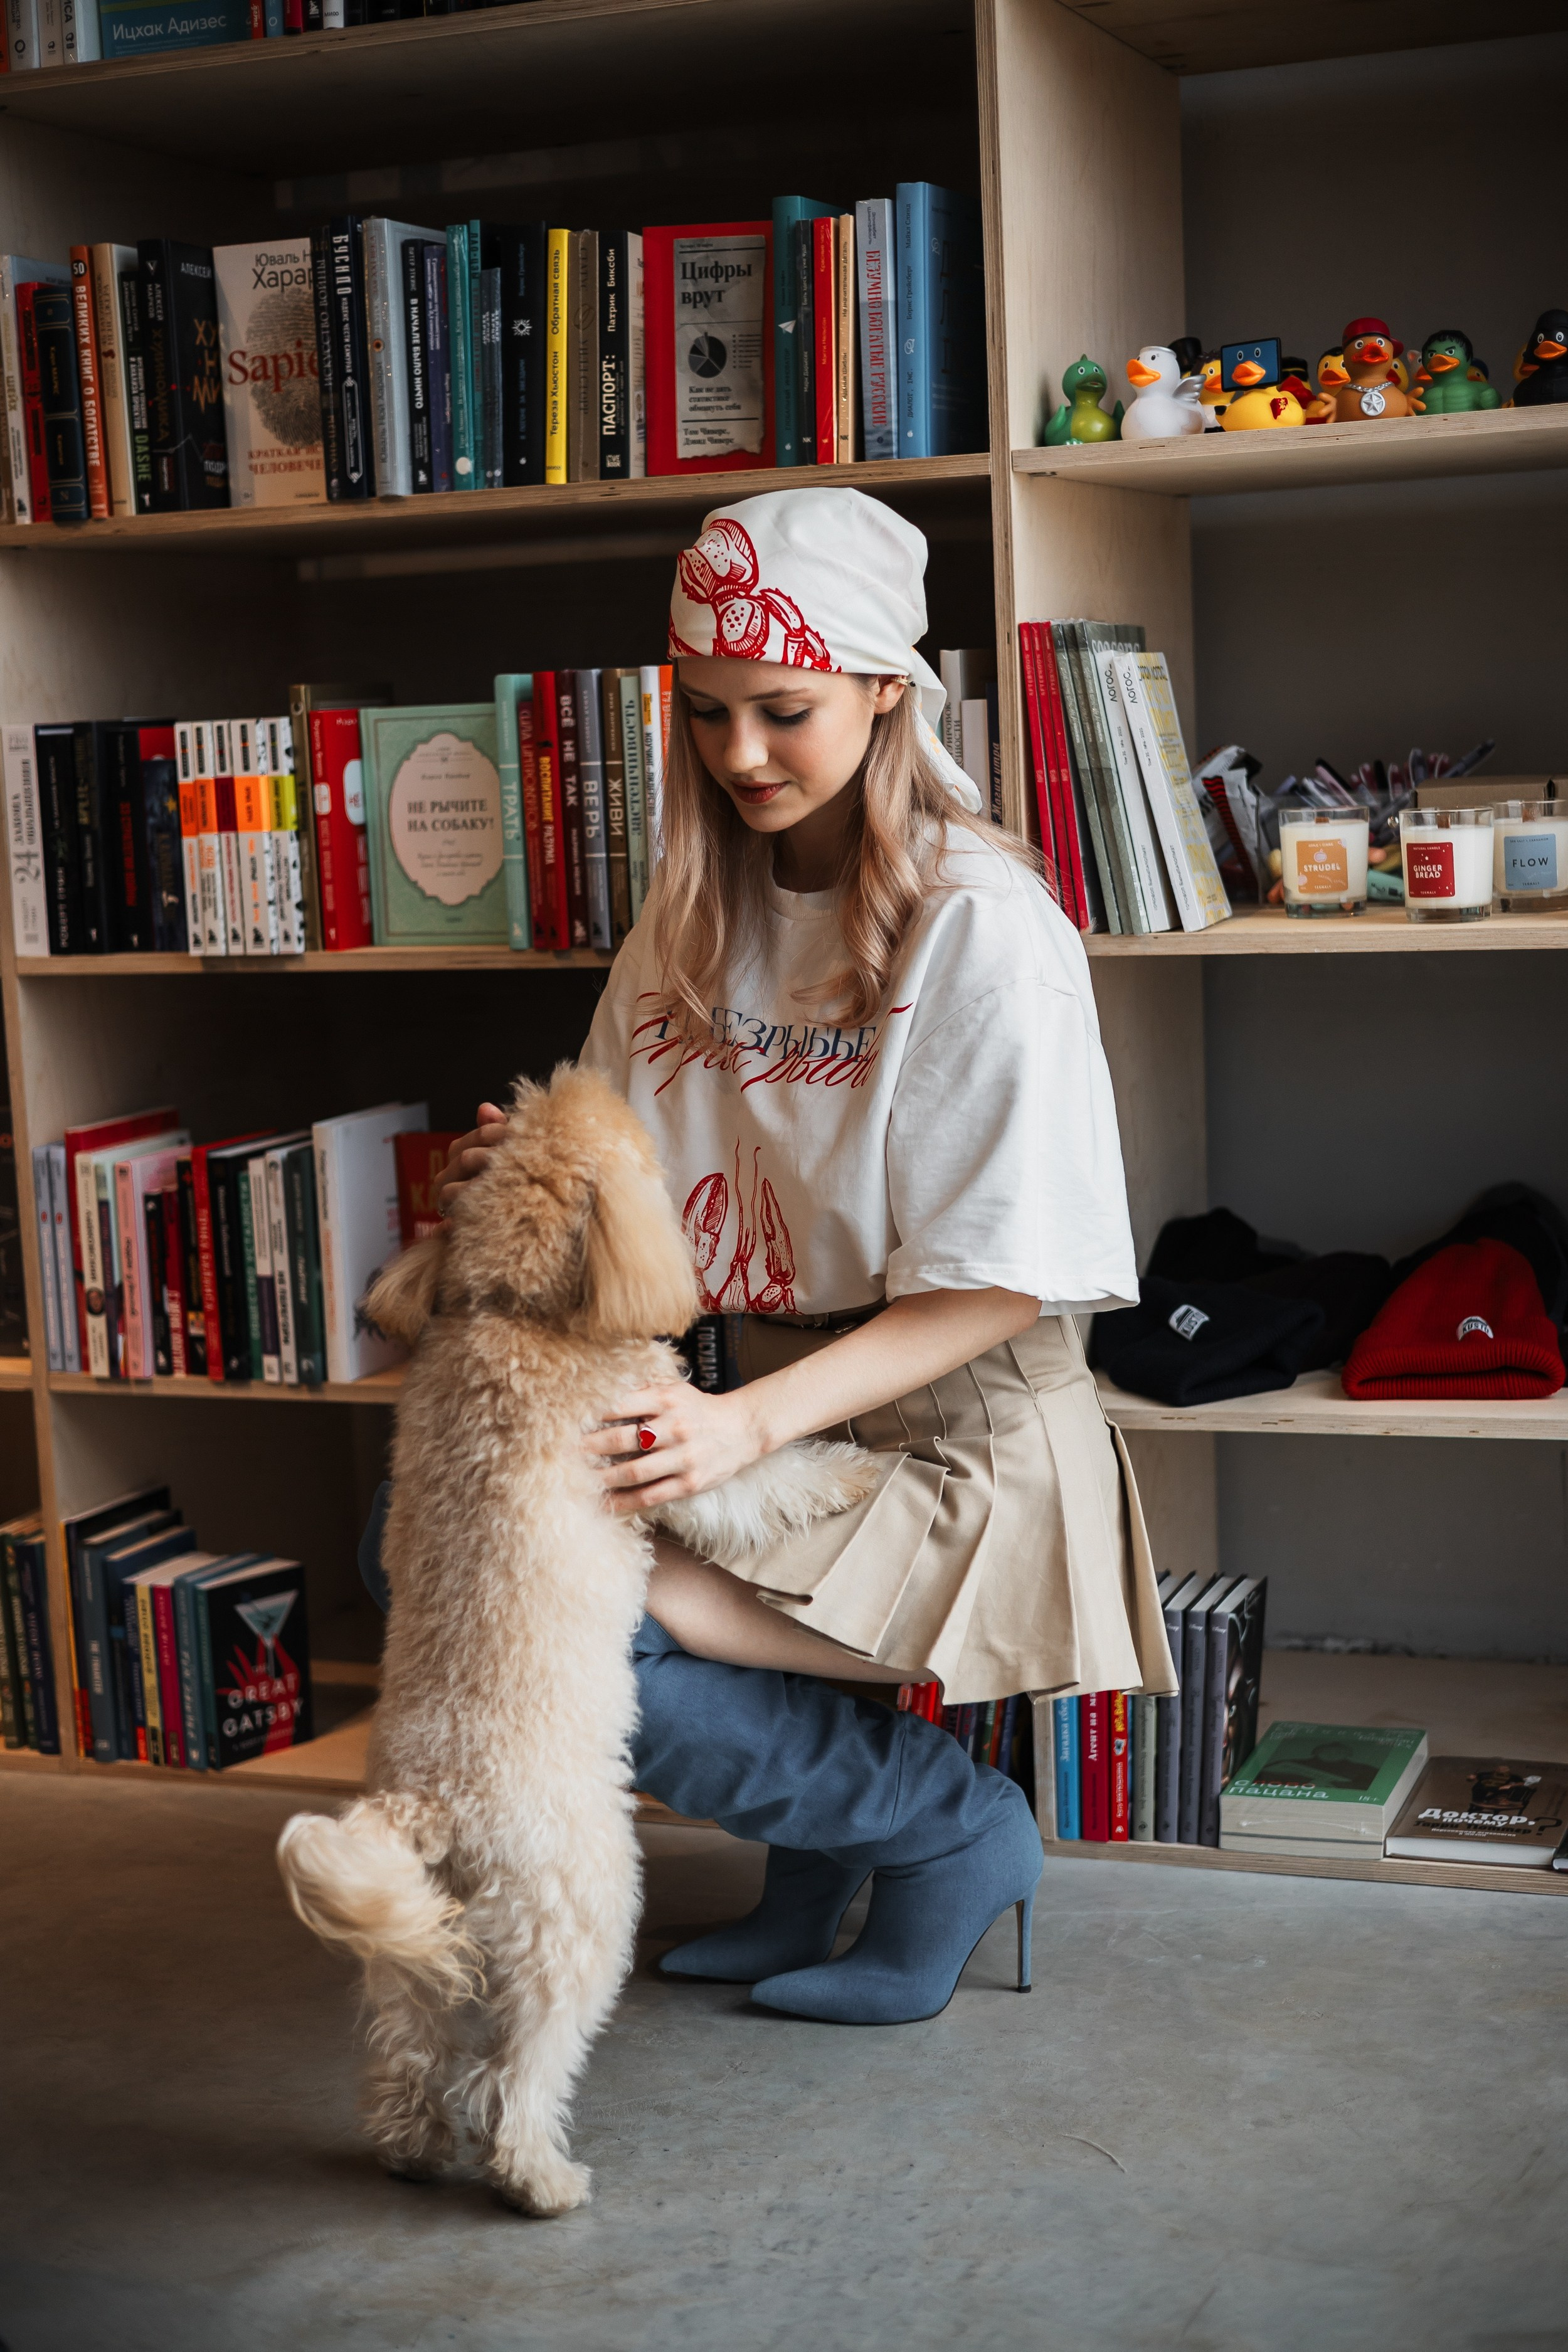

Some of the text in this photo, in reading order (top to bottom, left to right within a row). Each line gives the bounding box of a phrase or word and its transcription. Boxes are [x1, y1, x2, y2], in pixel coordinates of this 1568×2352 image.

[113, 15, 227, 40] Ицхак Адизес
[73, 263, 87, 275] 50
[255, 253, 300, 268] Юваль
[332, 235, 352, 295] БУСИДО
[408, 246, 416, 266] ПИТЕР
[681, 261, 752, 283] Цифры
[551, 249, 560, 335] Обратная связь
[606, 248, 618, 332] Патрик Биксби
[681, 290, 730, 309] врут
[905, 265, 913, 299] Гройсберг
[146, 284, 155, 319] МАРКОВ
[154, 283, 164, 320] АЛЕКСЕЙ
[315, 258, 334, 386] ИСКУССТВО ВОЙНЫ
[341, 297, 352, 373] КОДЕКС ЧЕСТИ САМУРАЯ
[410, 307, 421, 344] НАЧАЛЕ
[866, 250, 888, 428] БЕЗУМНО БОГАТЫЕ РУССКИЕ
[75, 286, 100, 467] ВЕЛИКИХ КНИГ О БОГАТСТВЕ
[411, 346, 422, 376] БЫЛО
[149, 329, 169, 442] ХУЛИНОМИКА
[413, 378, 425, 410] НИЧТО
[550, 351, 559, 436] Тереза Хьюстон
[601, 354, 617, 436] ПАСПОРТ:
[559, 695, 578, 807] ВСЁ НЕ ТАК
[624, 699, 642, 836] ЗАСТЕНЧИВОСТЬ
[991, 742, 1002, 819] Магия утра
[430, 798, 487, 813] РЫЧИТЕ
[502, 781, 519, 840] ТРАТЬ
[539, 755, 556, 865] ВОСПИТАНИЕ РАЗУМА
[582, 780, 600, 839] ВЕРЬ
[608, 777, 623, 837] ЖИВИ
[408, 819, 428, 833] НА
[12, 850, 40, 884] 24
[1303, 863, 1342, 872] STRUDEL
[1413, 864, 1443, 872] GINGER
[1512, 857, 1548, 867] FLOW
[222, 1697, 304, 1739] GATSBY
[1088, 1712, 1097, 1727] на
[1059, 1723, 1071, 1763] Загадка
[1088, 1729, 1099, 1762] Агент
[1228, 1784, 1330, 1799] пацана
[1233, 1778, 1315, 1789] слово
[1417, 1808, 1536, 1826] Доктор,
[1442, 1817, 1508, 1828] почему
